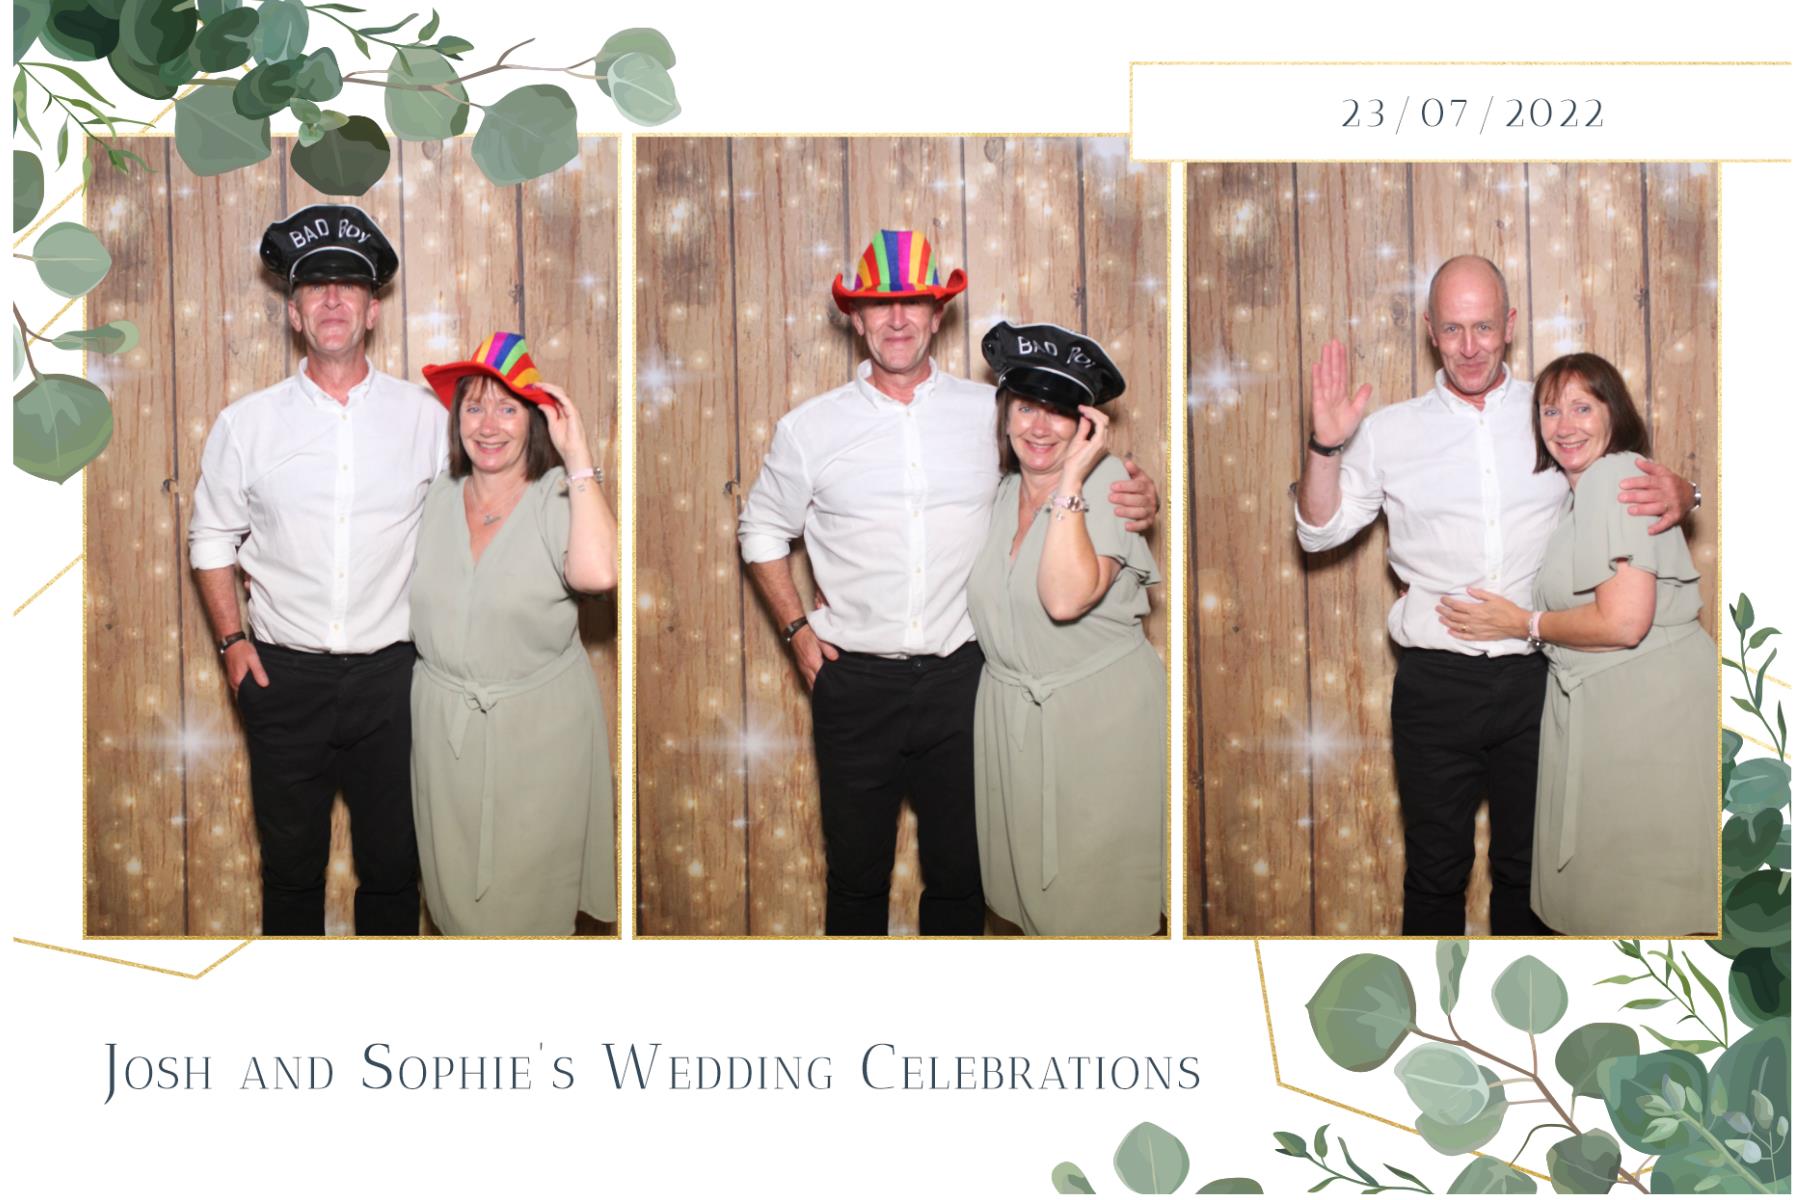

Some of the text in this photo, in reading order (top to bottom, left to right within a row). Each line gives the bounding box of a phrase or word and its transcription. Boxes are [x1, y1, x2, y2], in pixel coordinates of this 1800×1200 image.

[289, 218, 372, 249] BAD BOY
[1017, 336, 1059, 357] BAD
